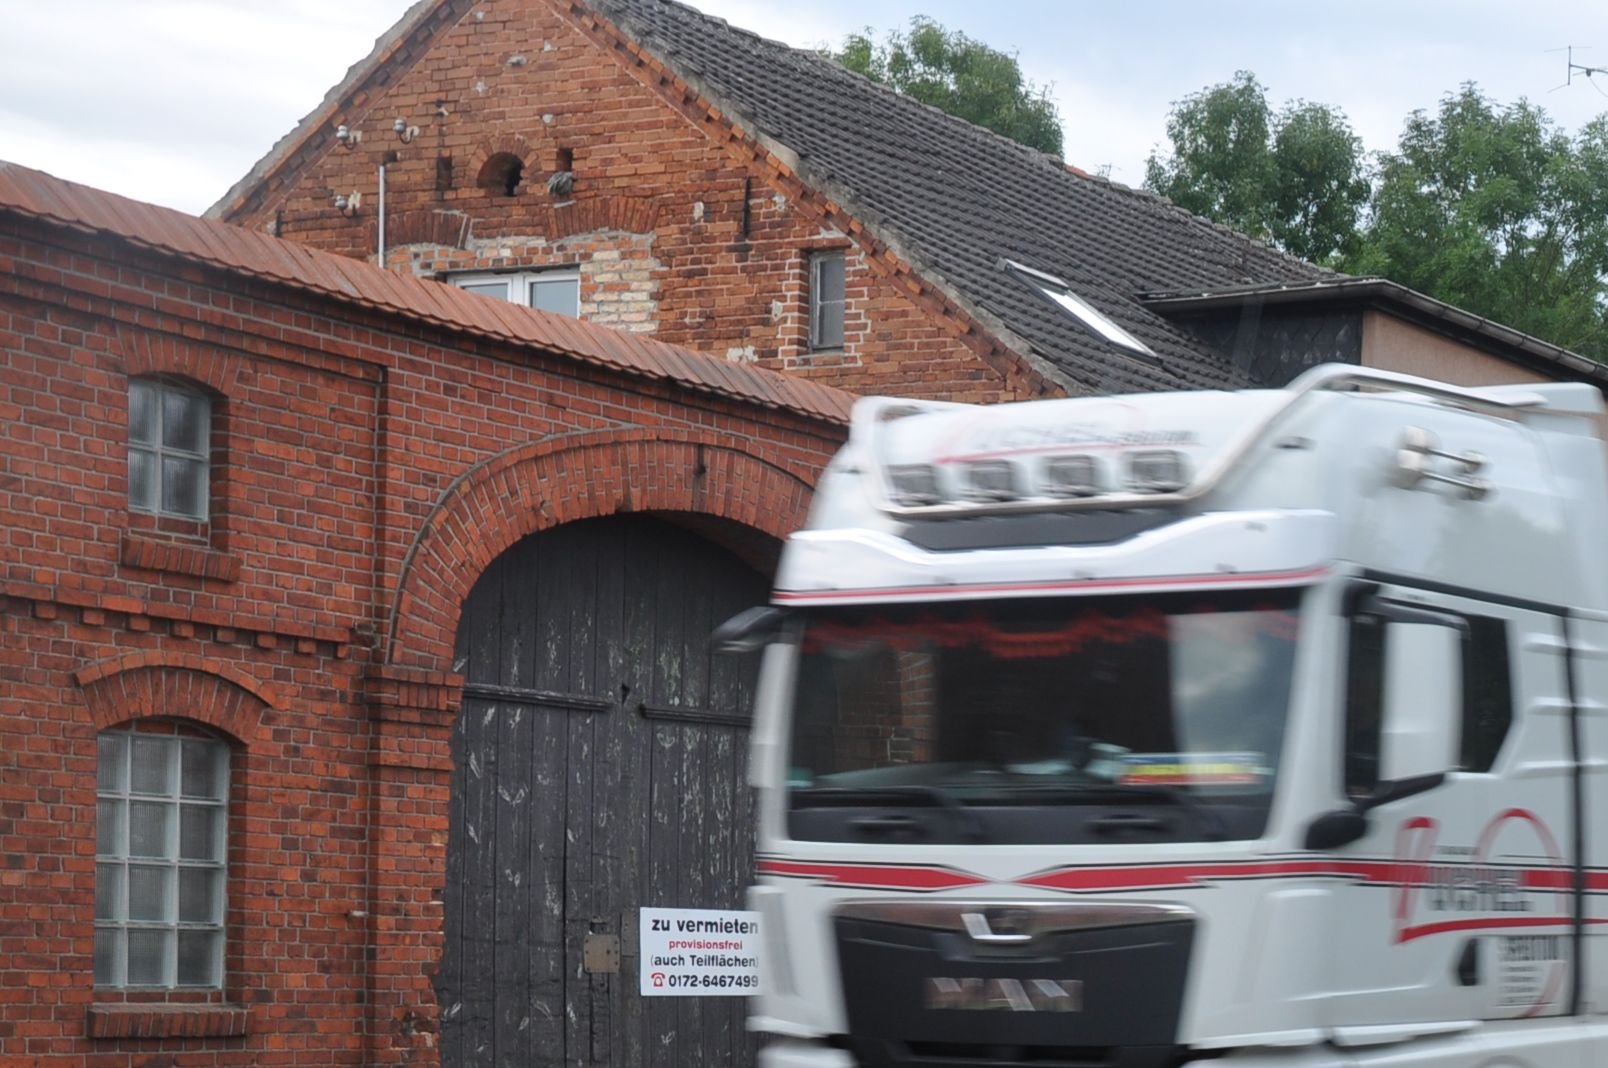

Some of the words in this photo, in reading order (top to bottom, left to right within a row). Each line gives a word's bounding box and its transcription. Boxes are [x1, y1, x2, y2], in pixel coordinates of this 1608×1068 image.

[651, 919, 671, 932] zu
[676, 917, 759, 934] vermieten
[668, 939, 743, 951] provisionsfrei
[650, 954, 686, 967] (auch
[689, 954, 759, 968] Teilflächen)
